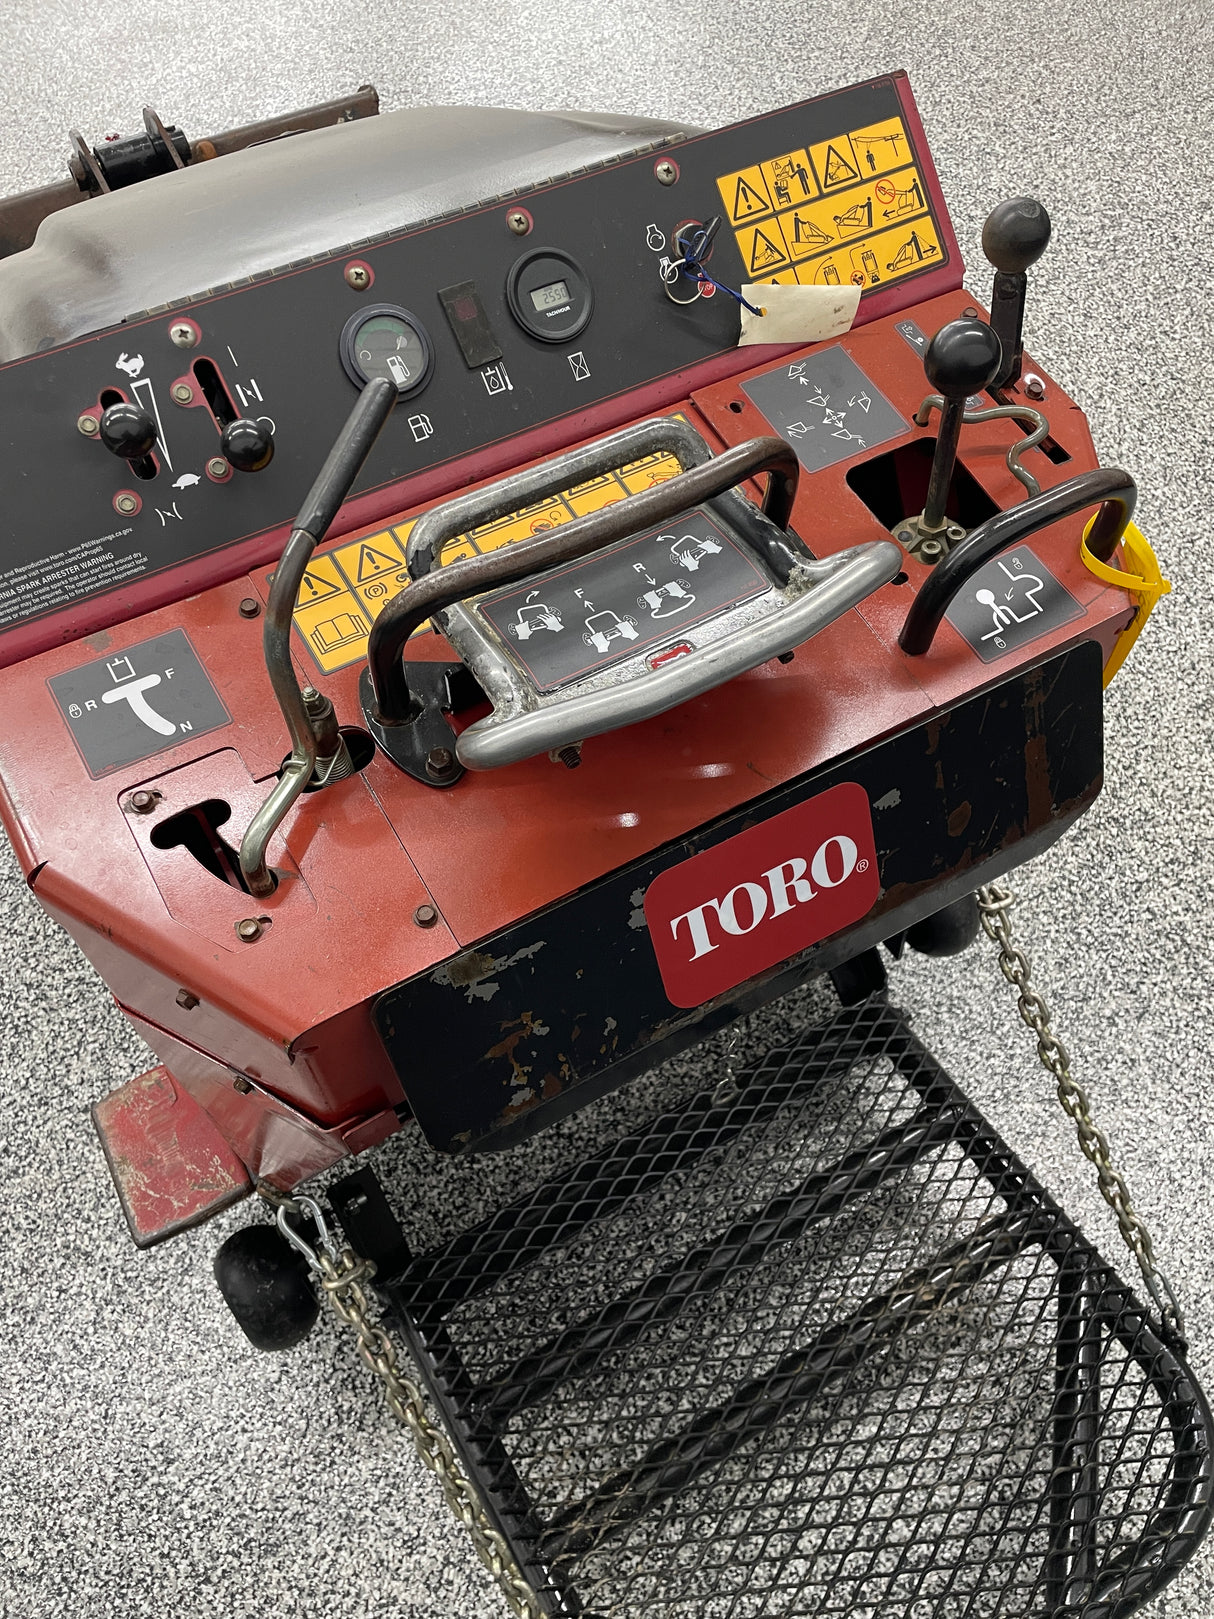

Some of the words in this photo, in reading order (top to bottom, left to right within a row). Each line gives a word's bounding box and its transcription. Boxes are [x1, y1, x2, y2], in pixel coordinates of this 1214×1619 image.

[14, 558, 50, 574] Reproductive
[49, 552, 65, 561] Harm
[632, 562, 646, 573] R
[16, 579, 42, 594] SPARK
[42, 565, 80, 584] ARRESTER
[80, 552, 114, 569] WARNING
[33, 586, 50, 596] create
[50, 579, 69, 589] sparks
[79, 571, 90, 579] can
[89, 566, 102, 575] start
[101, 562, 114, 570] fires
[114, 555, 133, 565] around
[76, 576, 97, 587] operator
[98, 568, 116, 579] should
[116, 561, 135, 572] contact
[135, 556, 148, 564] local
[9, 574, 28, 585] please
[19, 602, 49, 616] regulations
[49, 594, 69, 605] relating
[84, 578, 112, 592] prevention
[574, 588, 584, 599] F
[165, 668, 175, 680] F
[85, 700, 98, 712] R
[180, 721, 194, 733] N
